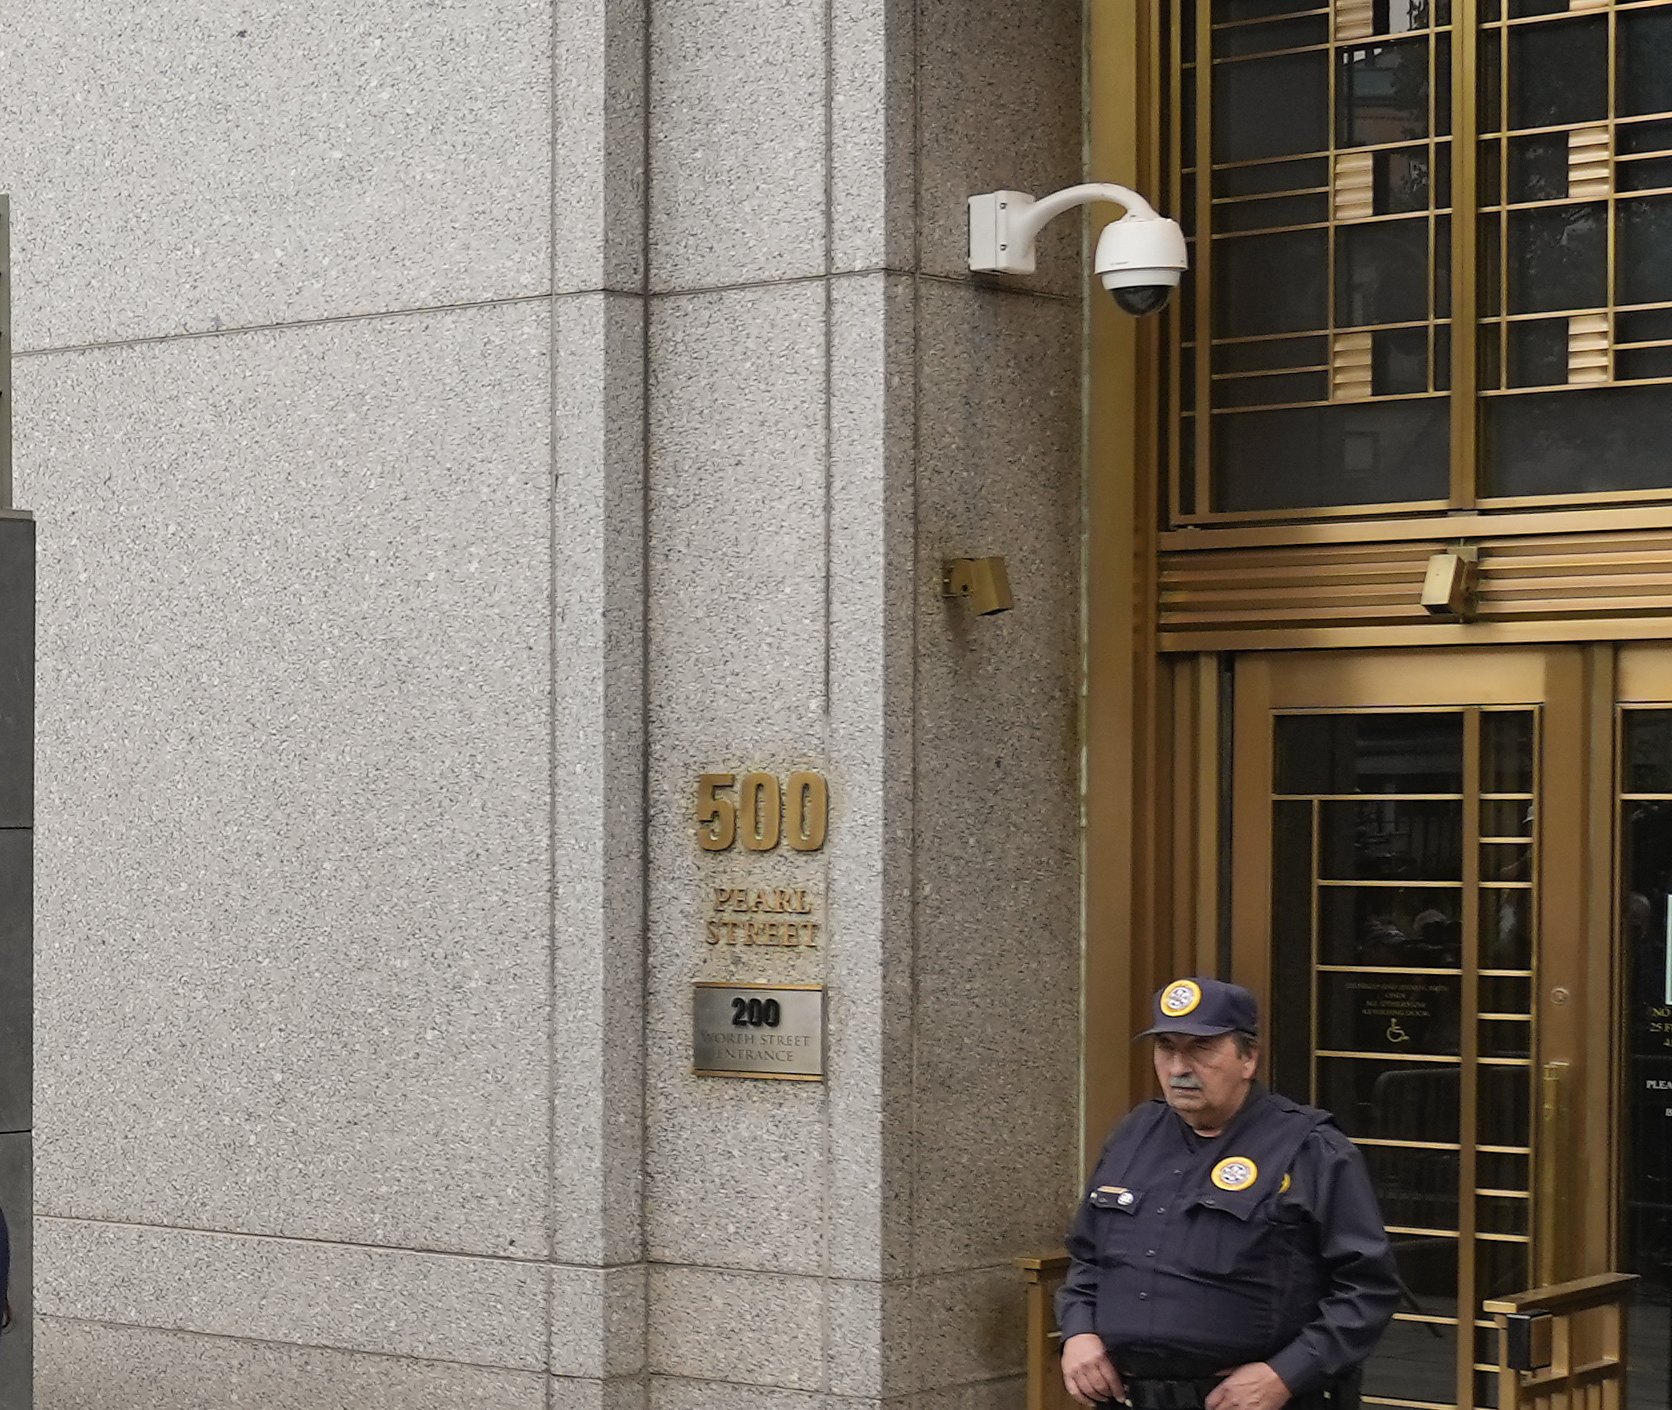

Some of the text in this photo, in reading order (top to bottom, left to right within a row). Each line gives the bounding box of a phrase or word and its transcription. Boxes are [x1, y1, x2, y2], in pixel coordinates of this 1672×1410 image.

[697, 772, 828, 851] 500
[714, 888, 812, 914] PEARL
[706, 921, 821, 947] STREET
[731, 996, 781, 1028] 200
[760, 1033, 811, 1047] STREET
[717, 1048, 794, 1062] ENTRANCE
